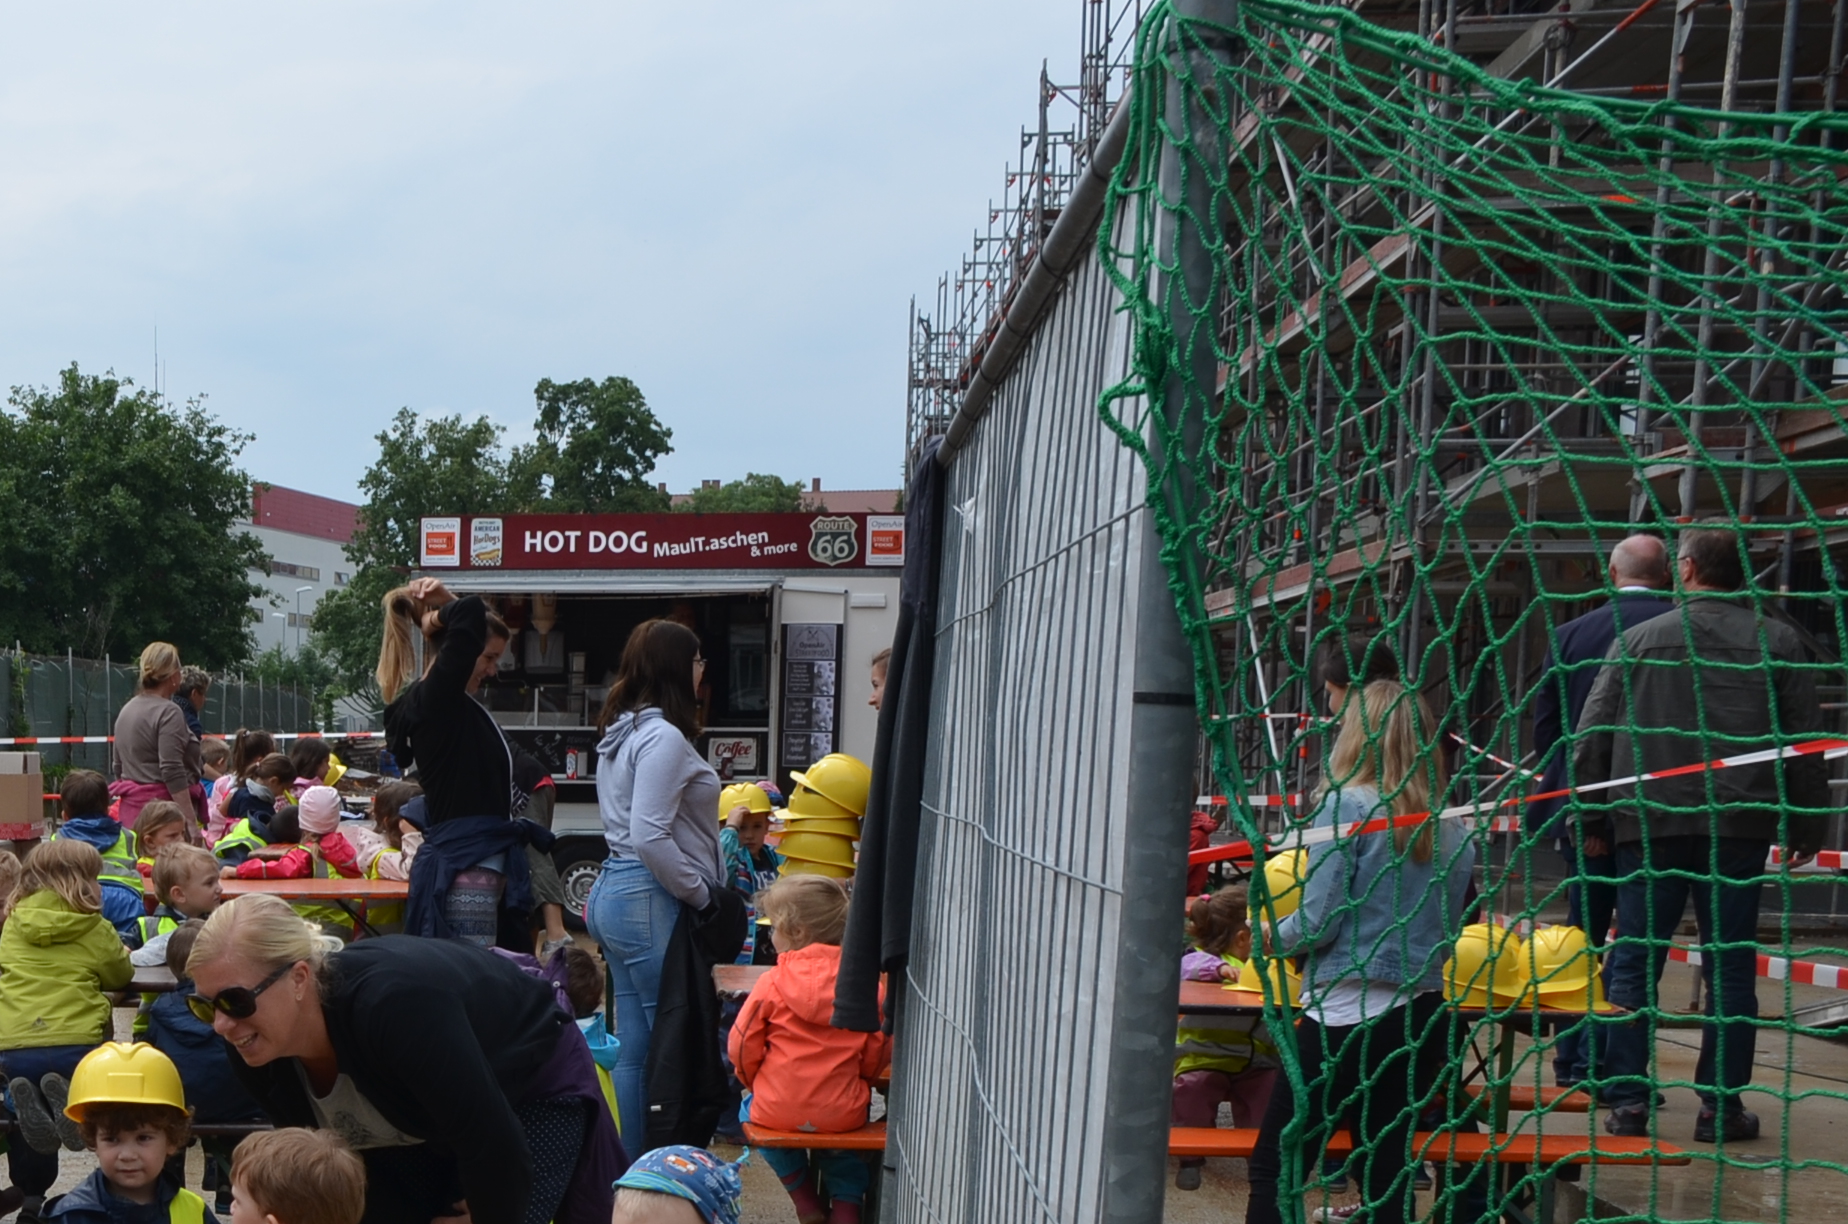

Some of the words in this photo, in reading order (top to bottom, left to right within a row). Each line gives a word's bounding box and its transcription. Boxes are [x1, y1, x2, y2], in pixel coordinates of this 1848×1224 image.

[816, 521, 850, 530] ROUTE
[524, 530, 582, 553] HOT
[588, 530, 648, 553] DOG
[653, 531, 769, 558] MaulT.aschen
[750, 545, 761, 558] &
[763, 541, 798, 556] more
[816, 534, 850, 558] 66
[715, 740, 752, 759] Coffee
